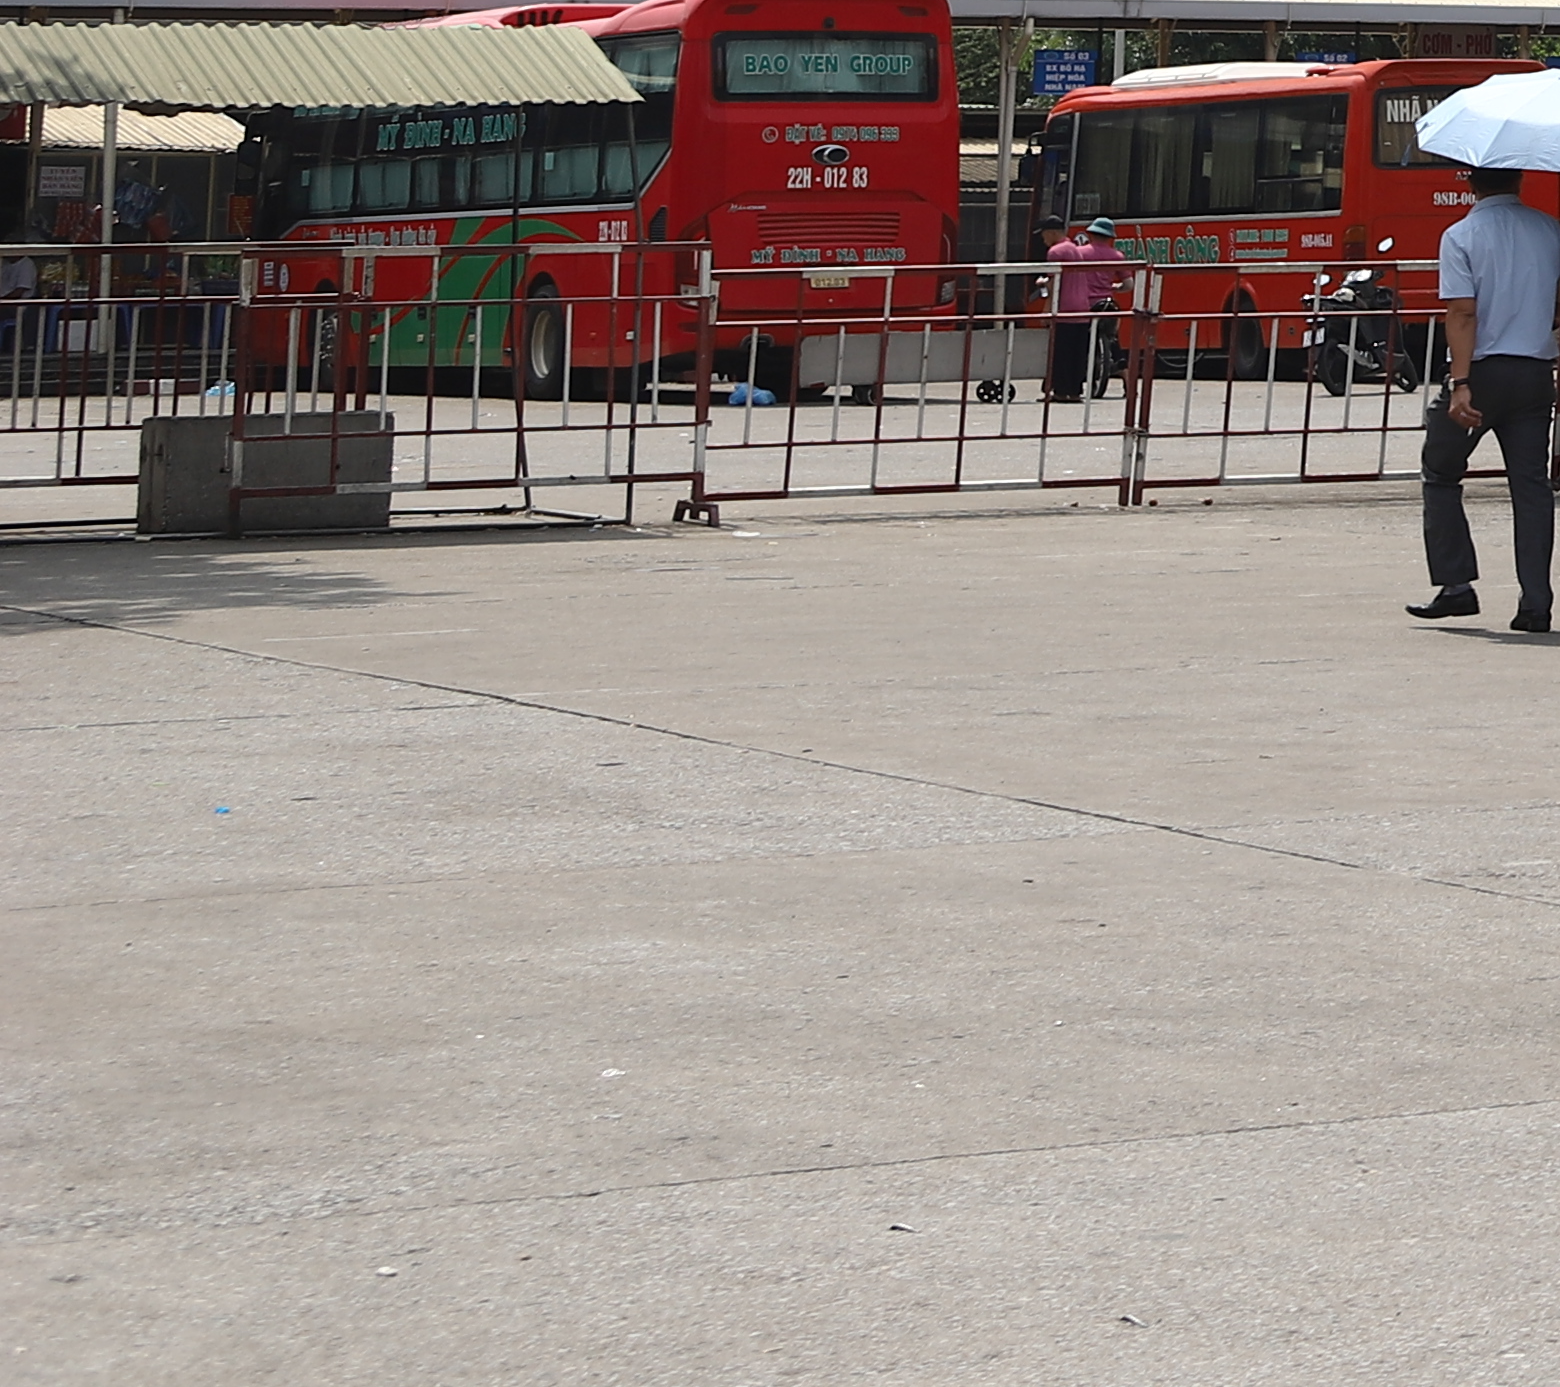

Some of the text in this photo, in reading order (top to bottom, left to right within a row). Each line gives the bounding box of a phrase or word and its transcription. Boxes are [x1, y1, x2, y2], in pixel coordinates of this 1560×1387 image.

[743, 54, 914, 76] BAO YEN GROUP
[1386, 95, 1422, 123] NHÃ
[376, 114, 401, 151] MỸ
[452, 117, 476, 145] NA
[787, 167, 869, 189] 22H 012 83
[751, 245, 906, 264] MỸ ĐÌNH NA HANG
[1113, 224, 1220, 264] THÀNH CÔNG
